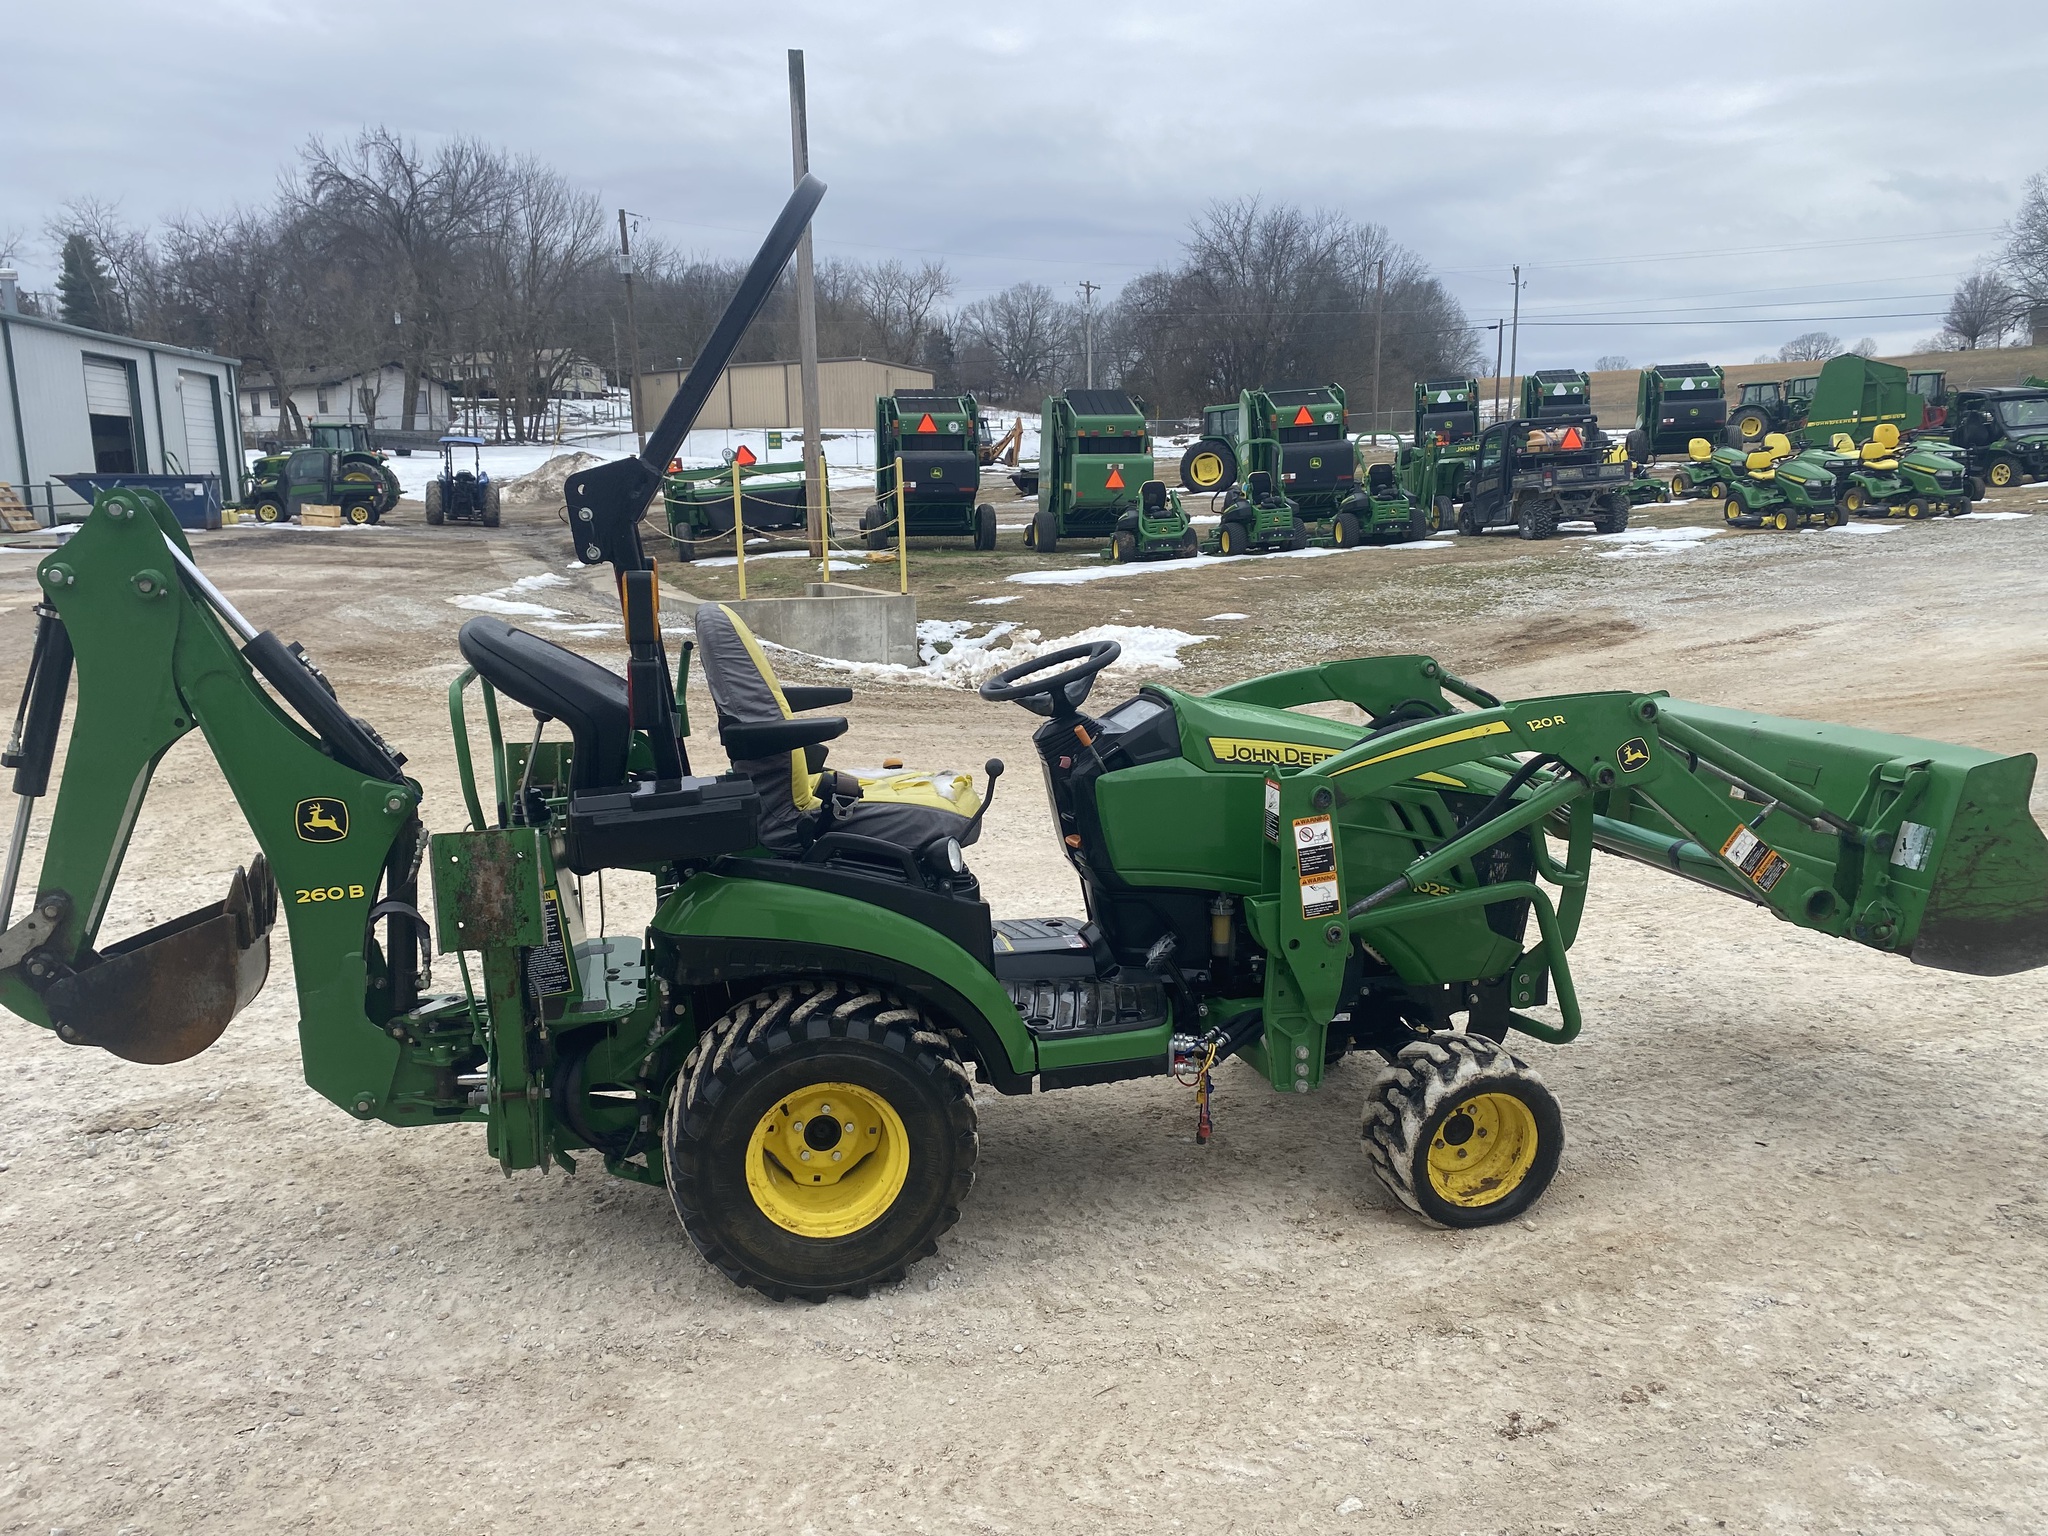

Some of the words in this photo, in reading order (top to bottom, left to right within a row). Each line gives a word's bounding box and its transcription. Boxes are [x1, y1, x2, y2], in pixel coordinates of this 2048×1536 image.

[1526, 717, 1553, 732] 120
[1553, 714, 1567, 726] R
[1226, 744, 1280, 762] JOHN
[1284, 747, 1334, 765] DEE
[1300, 815, 1330, 825] WARNING
[1307, 874, 1336, 884] WARNING
[295, 886, 345, 904] 260
[348, 884, 365, 899] B
